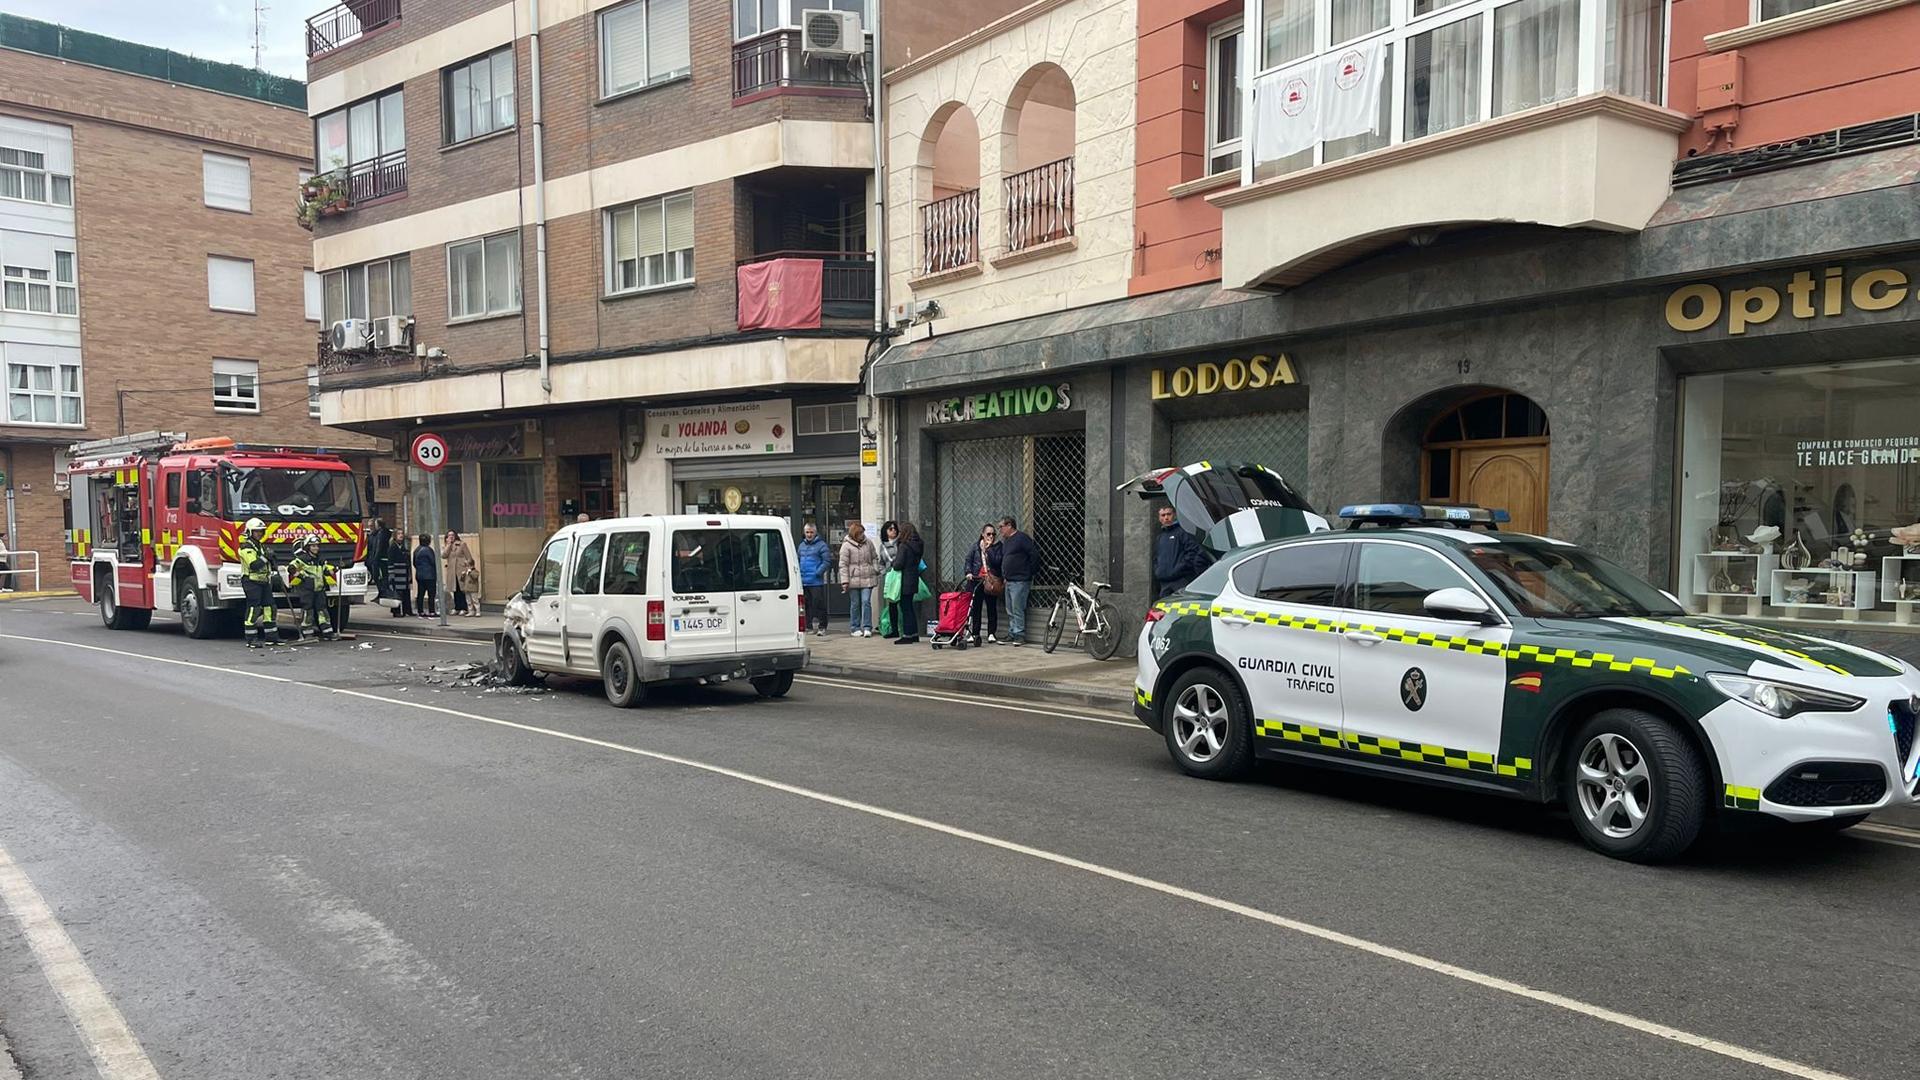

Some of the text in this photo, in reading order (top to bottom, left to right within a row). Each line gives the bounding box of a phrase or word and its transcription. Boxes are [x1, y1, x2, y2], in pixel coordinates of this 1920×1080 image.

[1665, 267, 1920, 334] Optic
[1457, 359, 1470, 374] 19
[1152, 353, 1298, 399] LODOSA
[926, 383, 1070, 424] RECREATIVOS
[678, 420, 727, 437] YOLANDA
[1797, 437, 1919, 450] COMPRAR EN COMERCIO PEQUEÑO
[420, 446, 441, 458] 30
[1797, 448, 1918, 466] TE HACE GRANDE
[682, 618, 723, 629] 1445 DCP
[1155, 637, 1171, 650] 062
[1238, 657, 1335, 679] GUARDIA CIVIL
[1286, 678, 1335, 694] TRÁFICO
